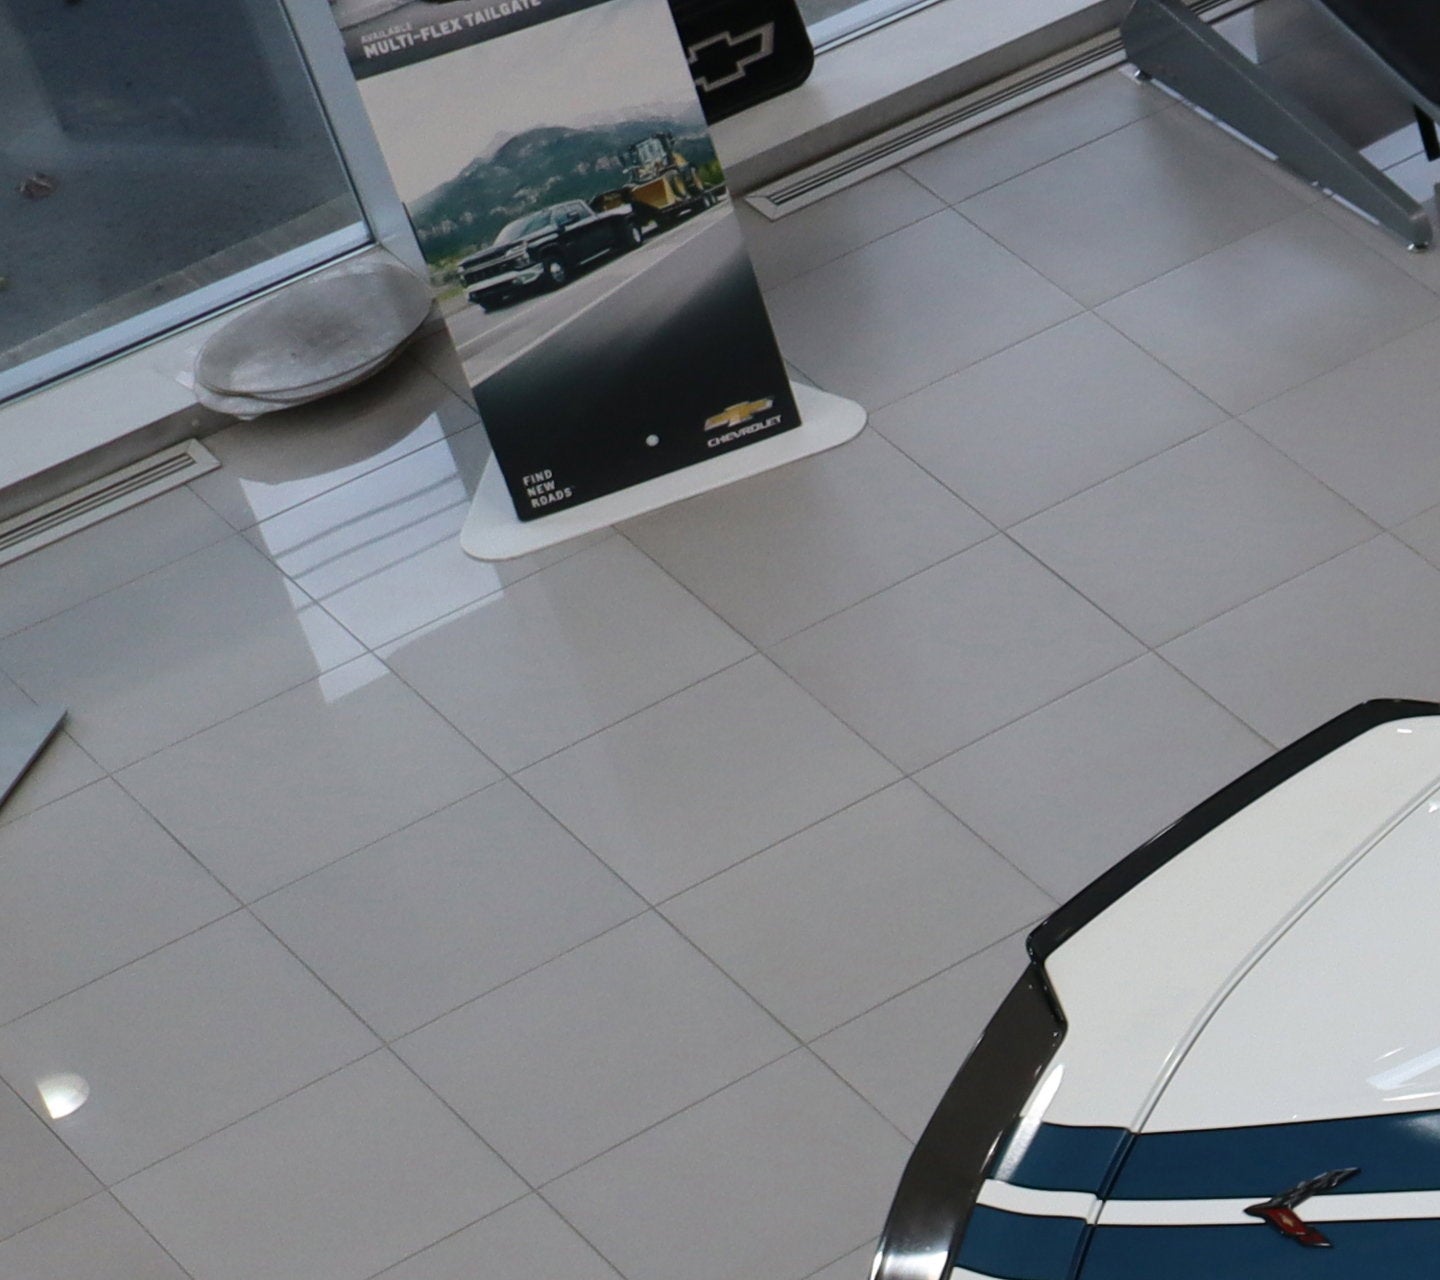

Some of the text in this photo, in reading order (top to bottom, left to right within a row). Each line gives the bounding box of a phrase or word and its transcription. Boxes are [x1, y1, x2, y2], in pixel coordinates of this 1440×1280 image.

[363, 18, 462, 59] MULTI-FLEX
[707, 415, 781, 448] CHEVROLET
[523, 469, 553, 486] FIND
[527, 480, 555, 497] NEW
[531, 487, 573, 508] ROADS
